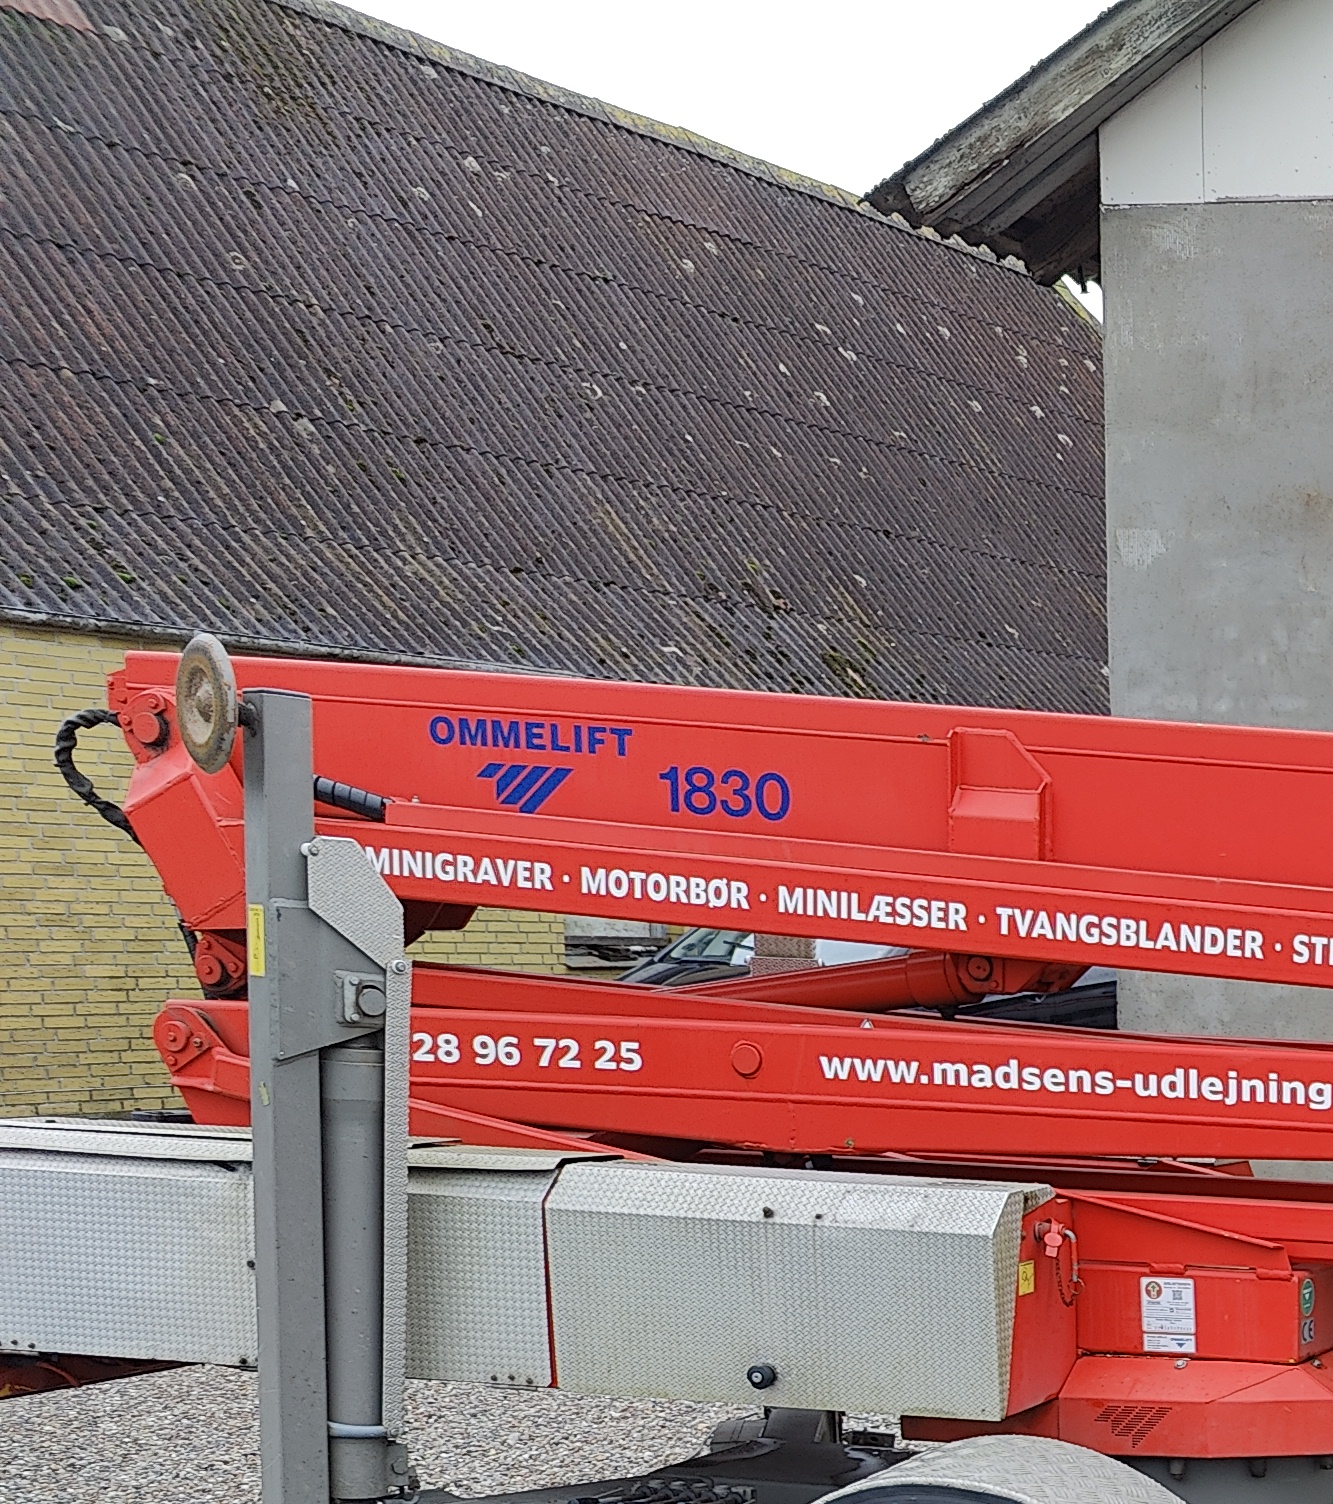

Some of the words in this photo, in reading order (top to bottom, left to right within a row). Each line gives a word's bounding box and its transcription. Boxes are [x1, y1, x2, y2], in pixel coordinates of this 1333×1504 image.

[429, 716, 633, 757] OMMELIFT
[659, 765, 791, 822] 1830
[364, 846, 554, 891] MINIGRAVER
[579, 866, 751, 911] MOTORBØR
[777, 885, 968, 931] MINILÆSSER
[995, 906, 1265, 960] TVANGSBLANDER
[411, 1032, 461, 1064] 28
[472, 1034, 521, 1066] 96
[533, 1037, 582, 1069] 72
[594, 1039, 643, 1072] 25
